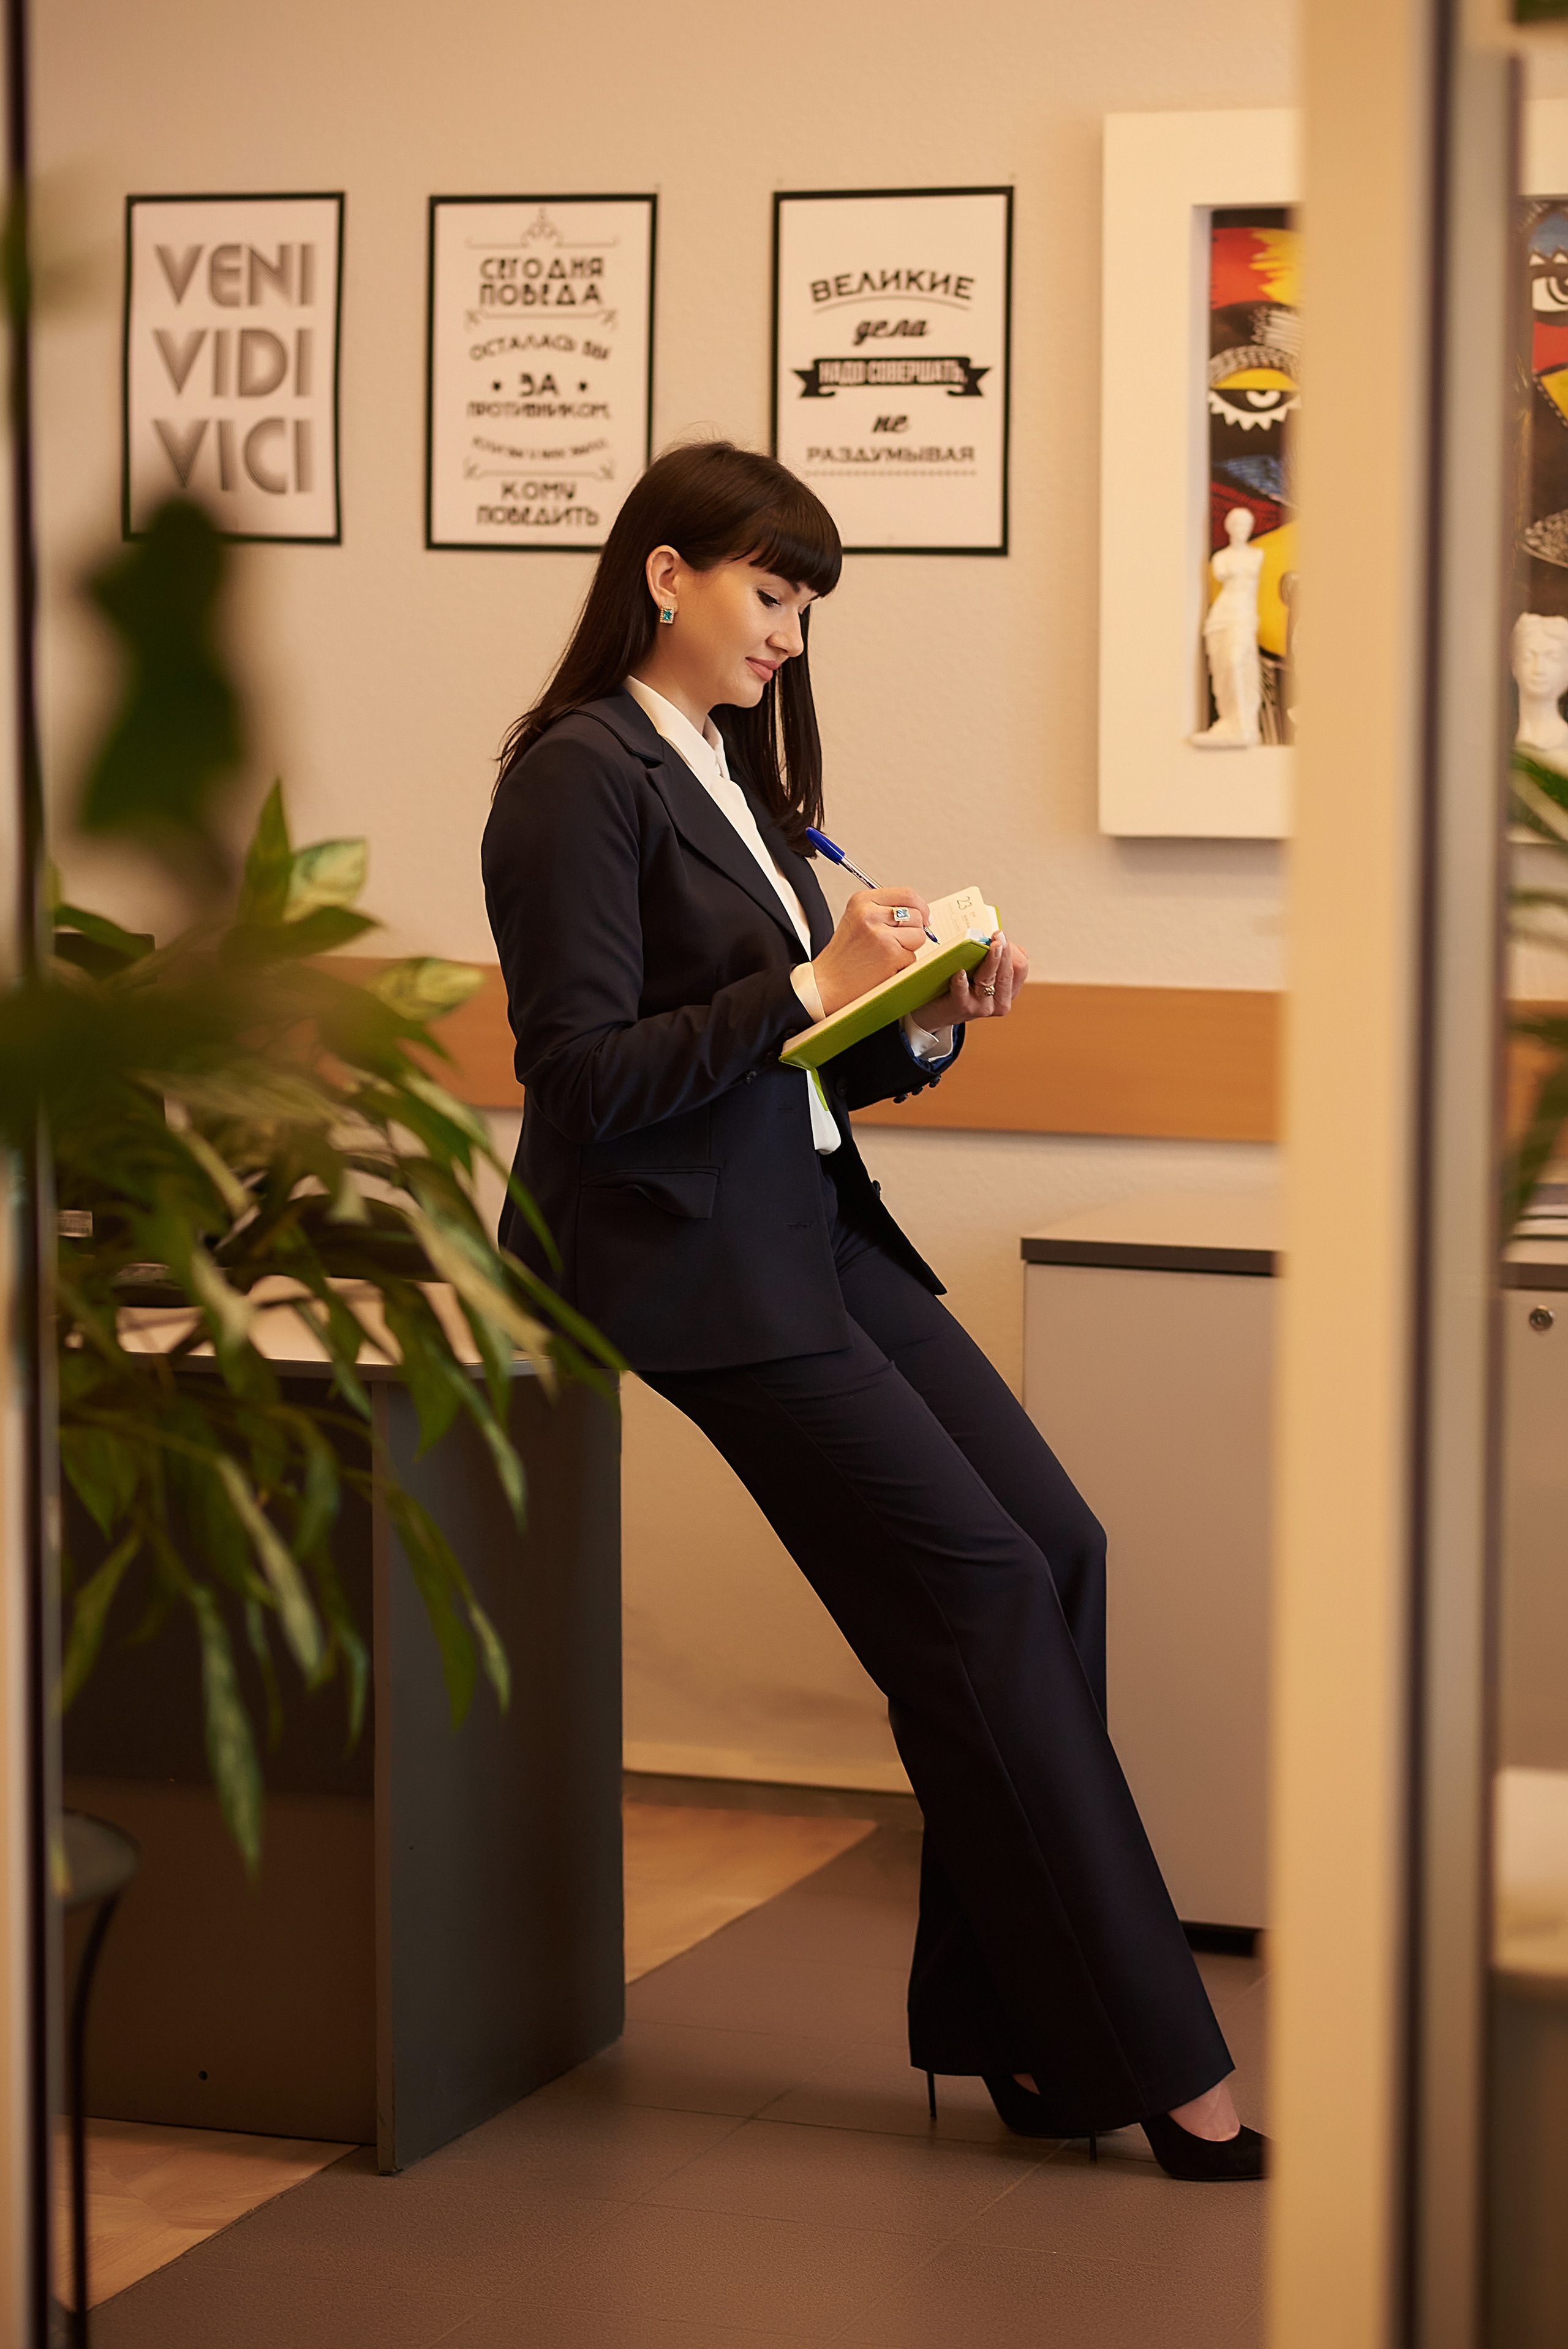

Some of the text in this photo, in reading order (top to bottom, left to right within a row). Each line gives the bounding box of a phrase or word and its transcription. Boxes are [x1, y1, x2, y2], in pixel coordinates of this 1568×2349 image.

[154, 242, 315, 308] VENI
[479, 256, 604, 280] СЕГОДНЯ
[479, 282, 602, 306] ПОБЕДА
[809, 268, 974, 303] ВЕЛИКИЕ
[853, 317, 929, 347] дела
[151, 327, 313, 398] VIDI
[519, 372, 559, 397] ЗА
[871, 414, 910, 433] не
[151, 415, 313, 495] VICI
[806, 445, 976, 463] РАЗДУМЫВАЯ
[956, 895, 973, 910] 23
